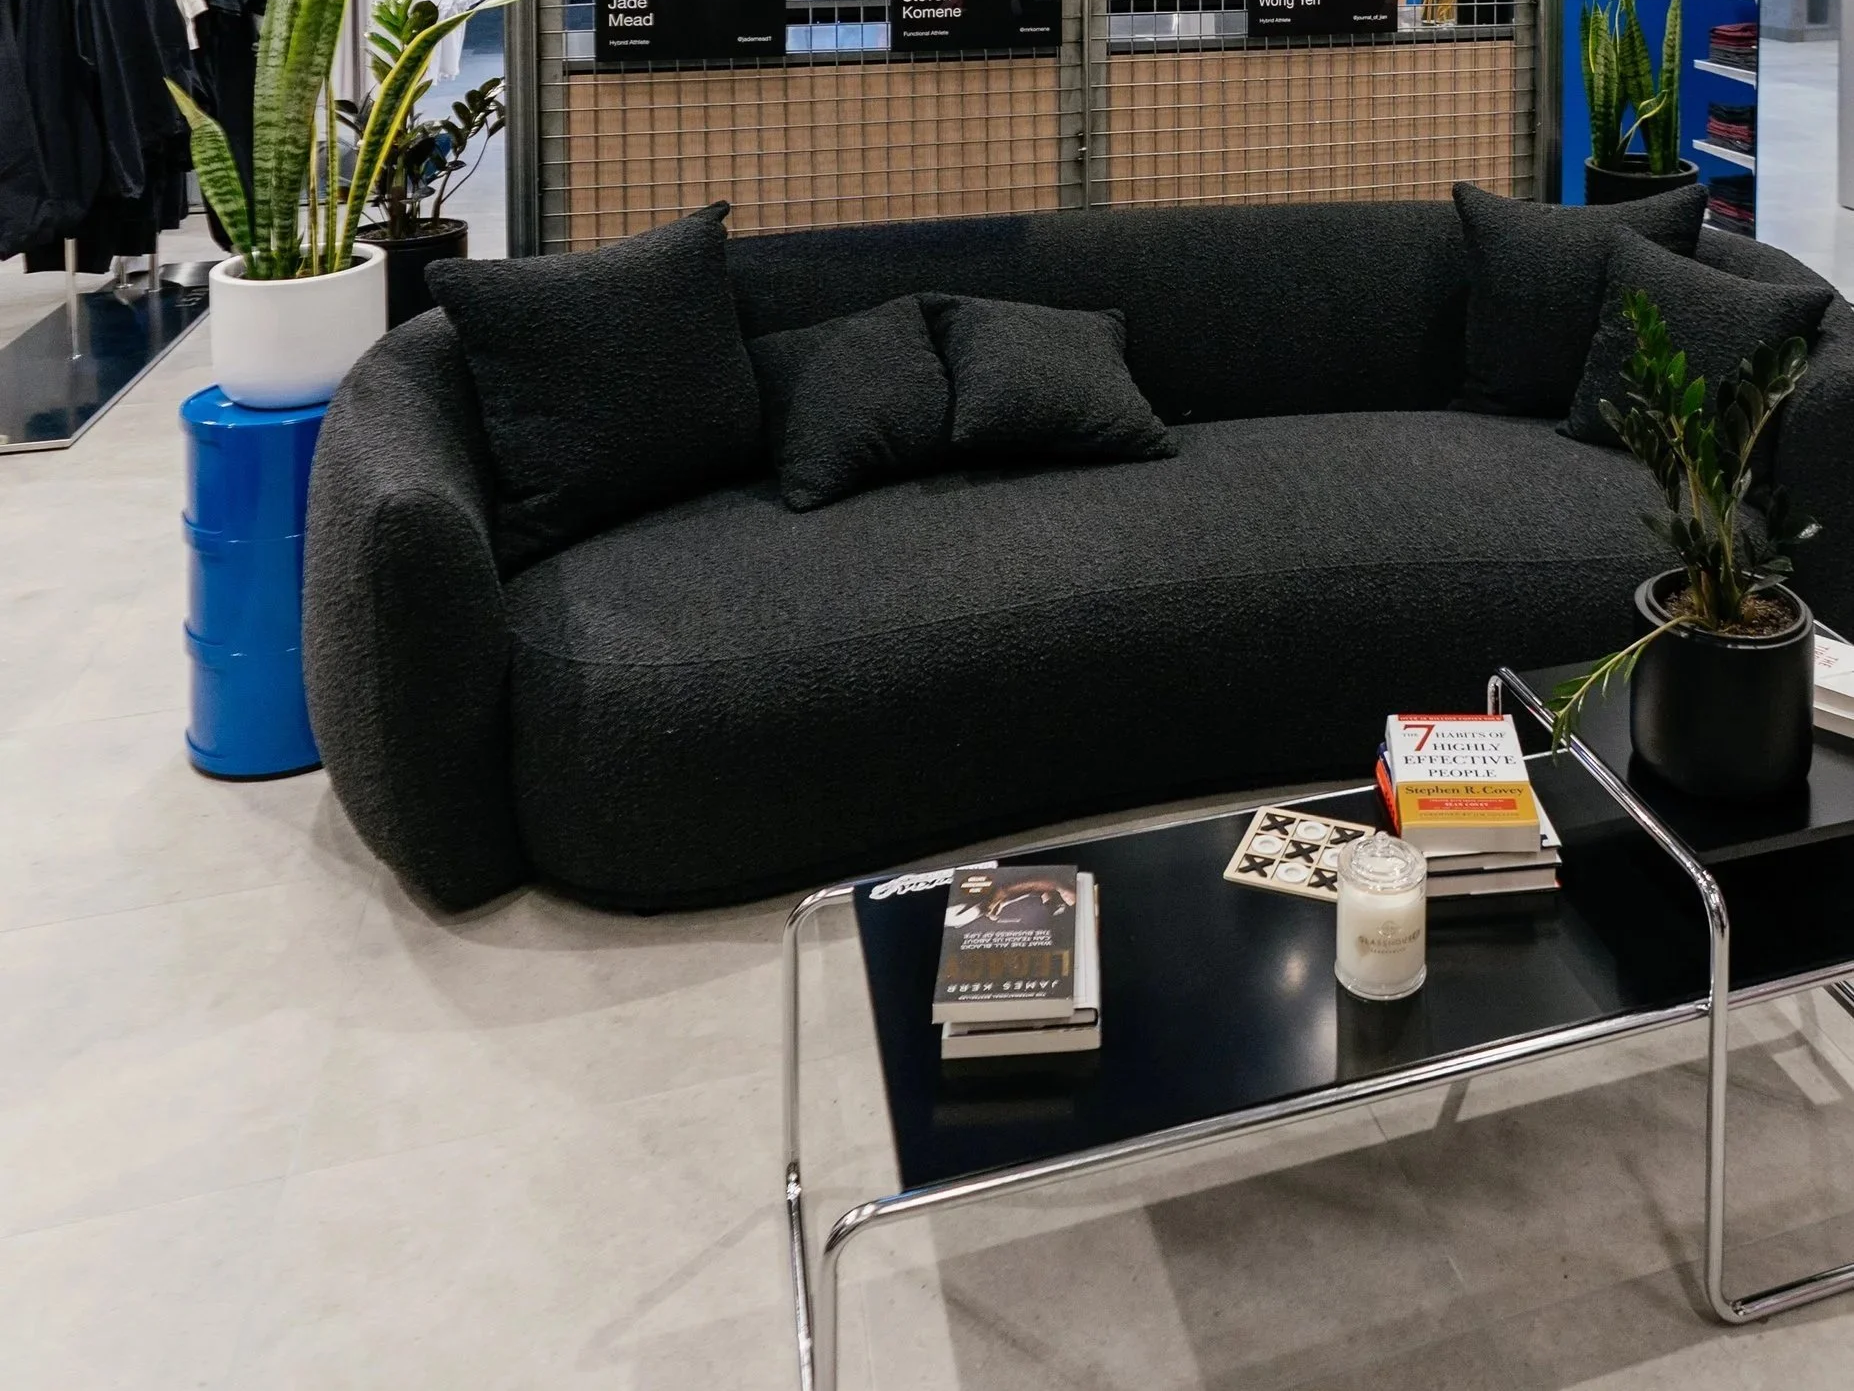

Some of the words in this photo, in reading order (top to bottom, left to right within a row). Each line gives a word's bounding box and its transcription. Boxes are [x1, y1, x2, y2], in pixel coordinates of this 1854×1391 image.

[902, 6, 962, 18] Komene
[609, 13, 654, 27] Mead
[1403, 724, 1436, 751] 7
[1433, 743, 1500, 751] HIGHLY
[1404, 755, 1517, 765] EFFECTIVE
[1429, 769, 1497, 778] PEOPLE
[1405, 786, 1460, 796] Stephen
[1464, 786, 1479, 794] R.
[1482, 787, 1524, 796] Covey
[947, 982, 993, 993] KERR
[1003, 980, 1059, 990] JAMES
